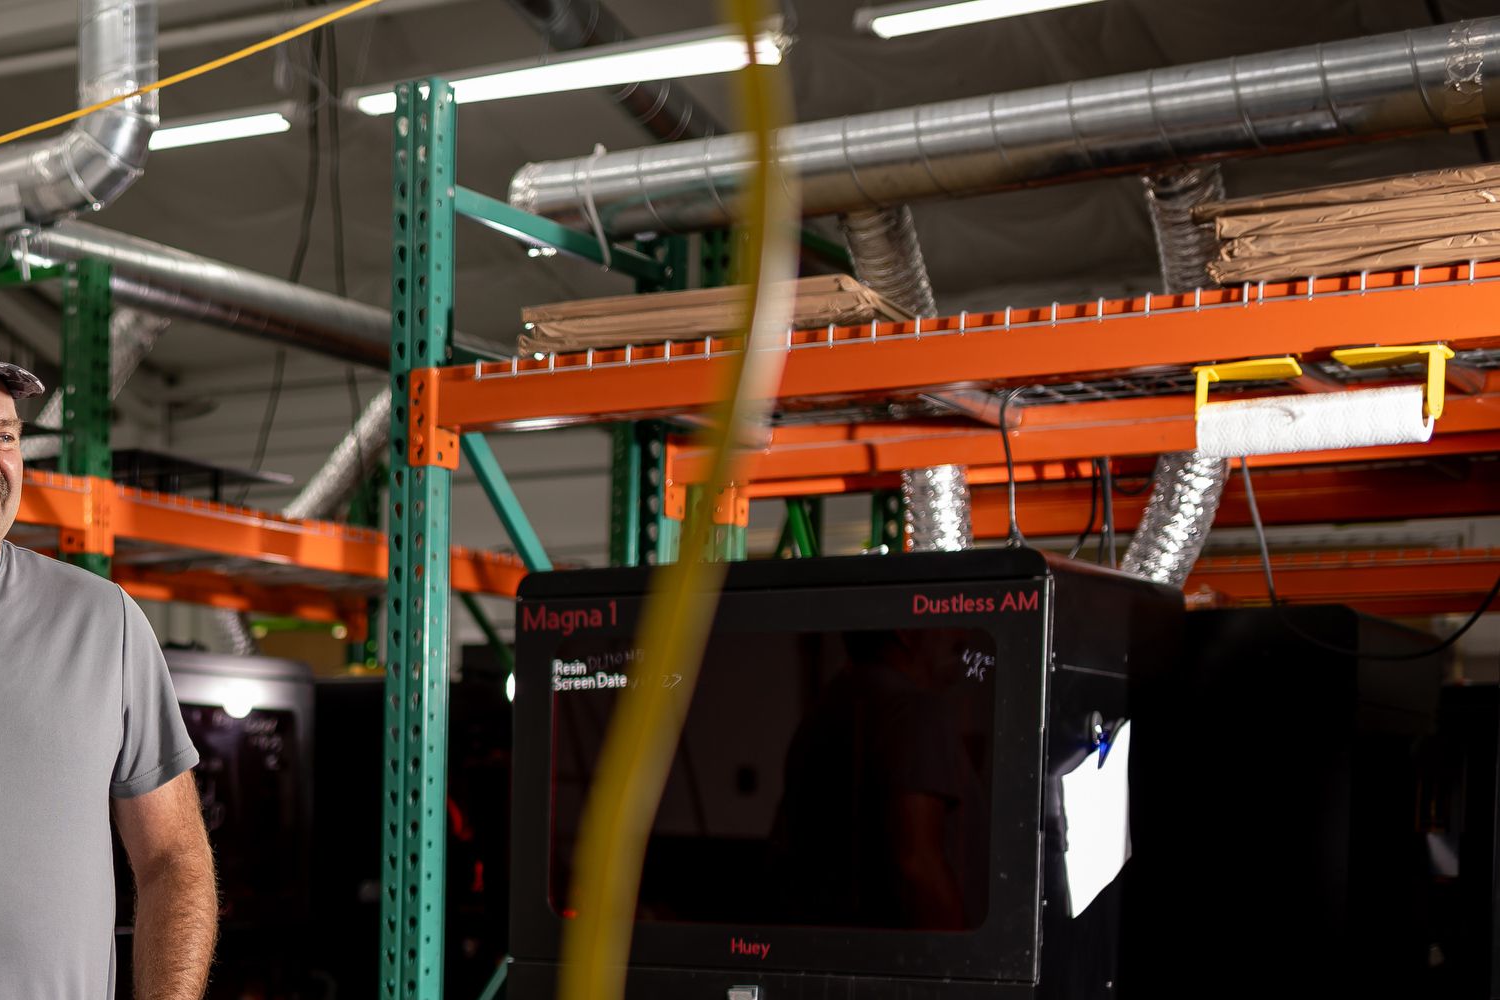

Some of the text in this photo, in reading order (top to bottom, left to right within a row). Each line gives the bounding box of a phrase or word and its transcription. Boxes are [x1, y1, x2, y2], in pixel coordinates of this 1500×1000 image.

[912, 590, 1039, 615] Dustless AM
[523, 600, 618, 636] Magna 1
[553, 660, 587, 676] Resin
[554, 675, 596, 692] Screen
[596, 671, 628, 689] Date
[730, 938, 771, 960] Huey
